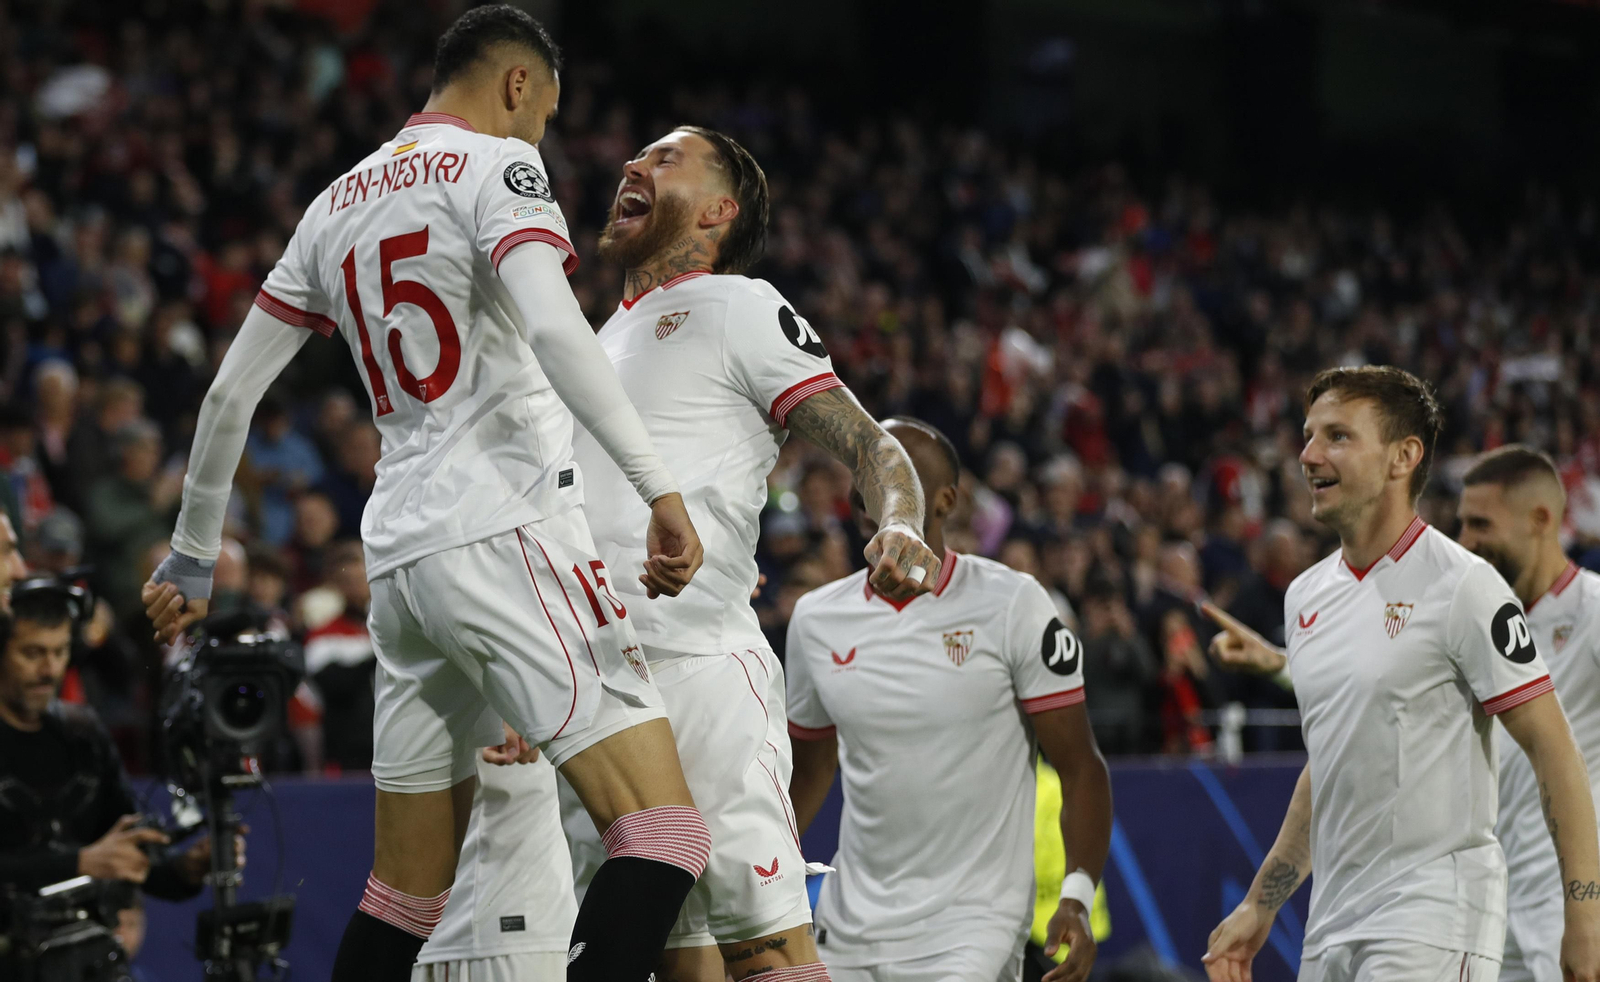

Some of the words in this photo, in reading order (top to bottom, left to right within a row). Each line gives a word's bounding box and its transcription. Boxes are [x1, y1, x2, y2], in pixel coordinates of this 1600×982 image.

[329, 151, 469, 216] Y.EN-NESYRI
[341, 224, 462, 417] 15
[572, 559, 627, 628] 15
[1049, 628, 1076, 667] JD
[1504, 613, 1531, 657] JD
